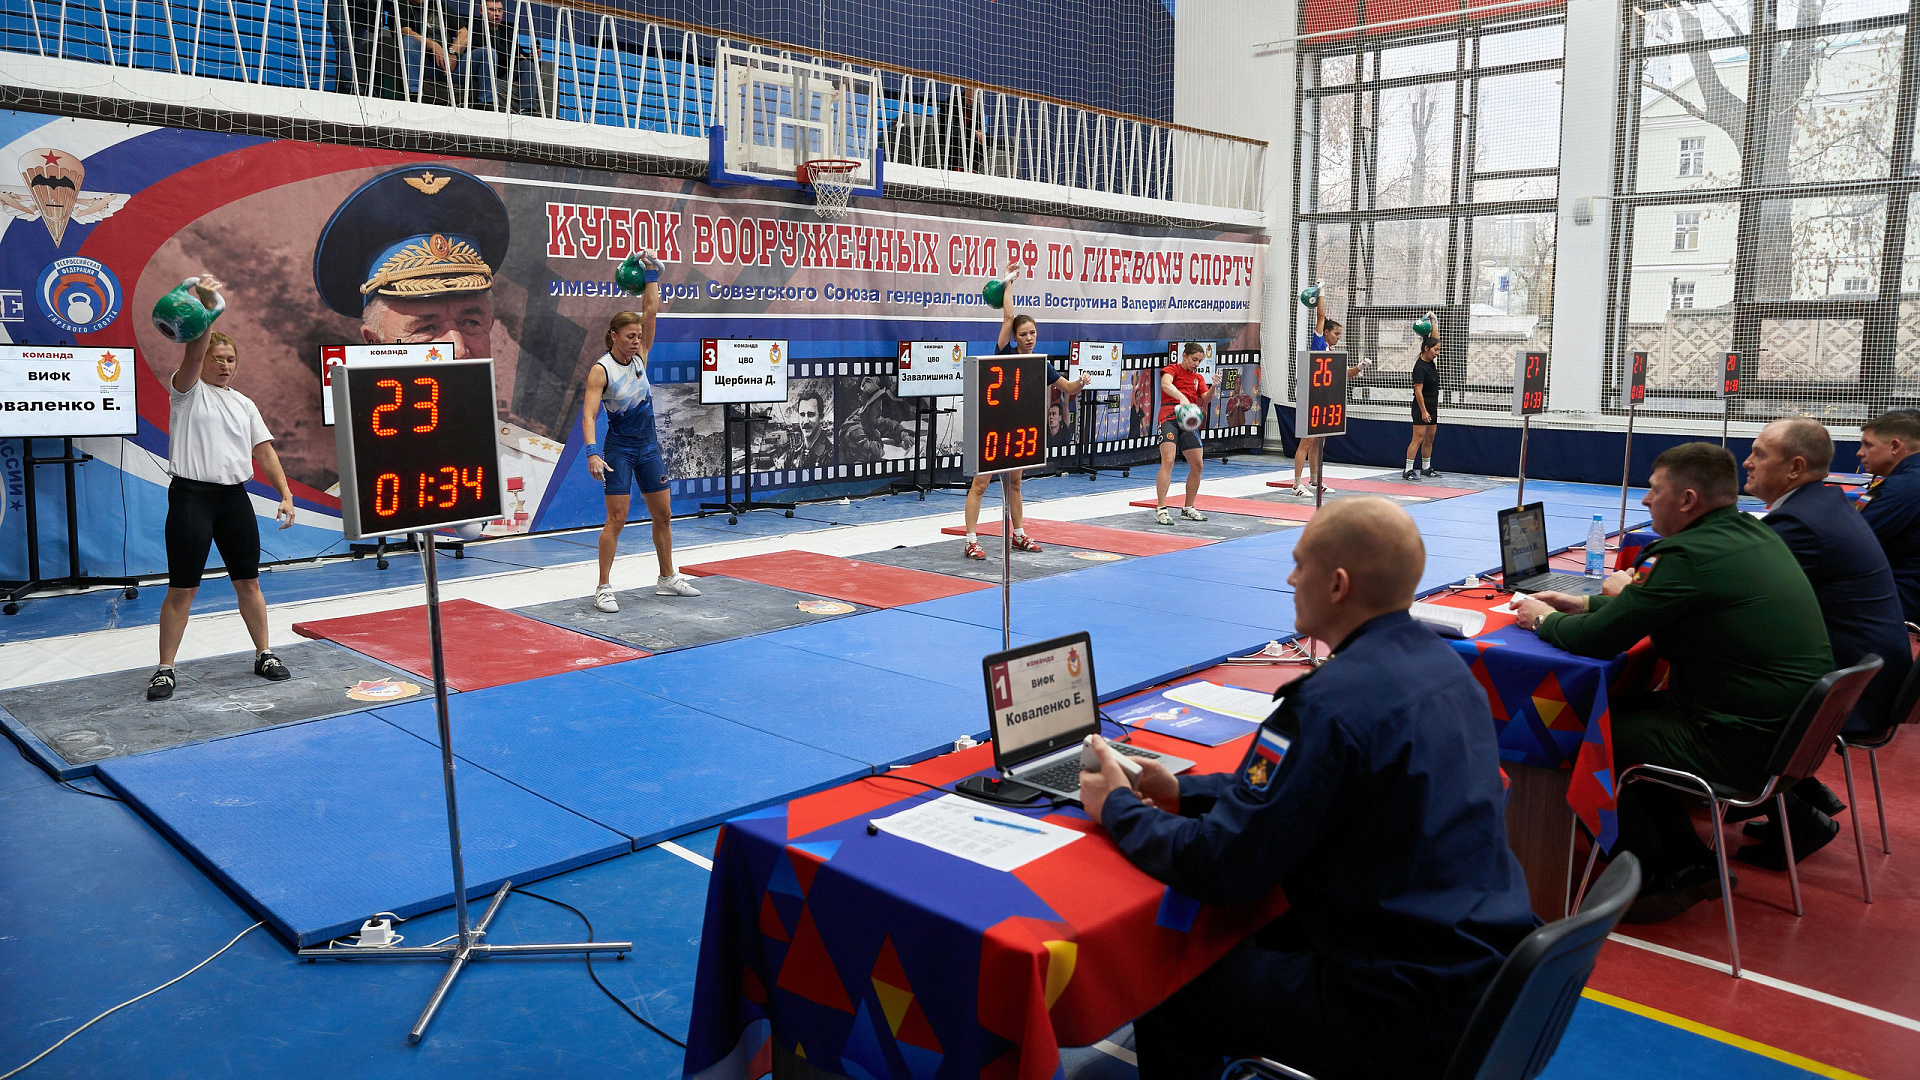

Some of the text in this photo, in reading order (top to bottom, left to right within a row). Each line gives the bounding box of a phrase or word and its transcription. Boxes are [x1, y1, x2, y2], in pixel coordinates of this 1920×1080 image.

[546, 202, 1254, 287] КУБОК ВООРУЖЕННЫХ СИЛ РФ ПО ГИРЕВОМУ СПОРТУ
[55, 258, 102, 270] ВСЕРОССИЙСКАЯ
[61, 266, 95, 276] ФЕДЕРАЦИЯ
[705, 279, 818, 301] Советского
[824, 283, 880, 303] Союза
[1045, 292, 1118, 312] Востротина
[1121, 296, 1167, 312] Валерия
[1167, 297, 1250, 312] Александровича
[47, 310, 118, 333] ГИРЕВОГО СПОРТА
[22, 352, 74, 360] команда
[370, 348, 408, 356] команда
[704, 347, 716, 366] 3
[900, 348, 911, 364] 4
[927, 356, 940, 364] ЦВО
[1071, 348, 1079, 361] 5
[1170, 350, 1178, 363] 6
[738, 357, 754, 365] ЦВО
[1526, 356, 1540, 379] 27
[1633, 355, 1643, 375] 21
[28, 371, 71, 381] ВИФК
[714, 374, 776, 387] Щербина Д.
[901, 371, 964, 382] Завалишина А.
[1105, 368, 1113, 377] Д.
[1313, 358, 1333, 387] 26
[987, 366, 1021, 406] 21
[0, 397, 121, 411] валенко Е.
[372, 377, 439, 436] 23
[375, 466, 483, 516] 01:34
[1503, 524, 1510, 541] 2
[1026, 655, 1055, 668] команда
[995, 675, 1008, 700] 1
[1031, 673, 1056, 689] ВИФК
[1006, 692, 1086, 727] Коваленко Е.
